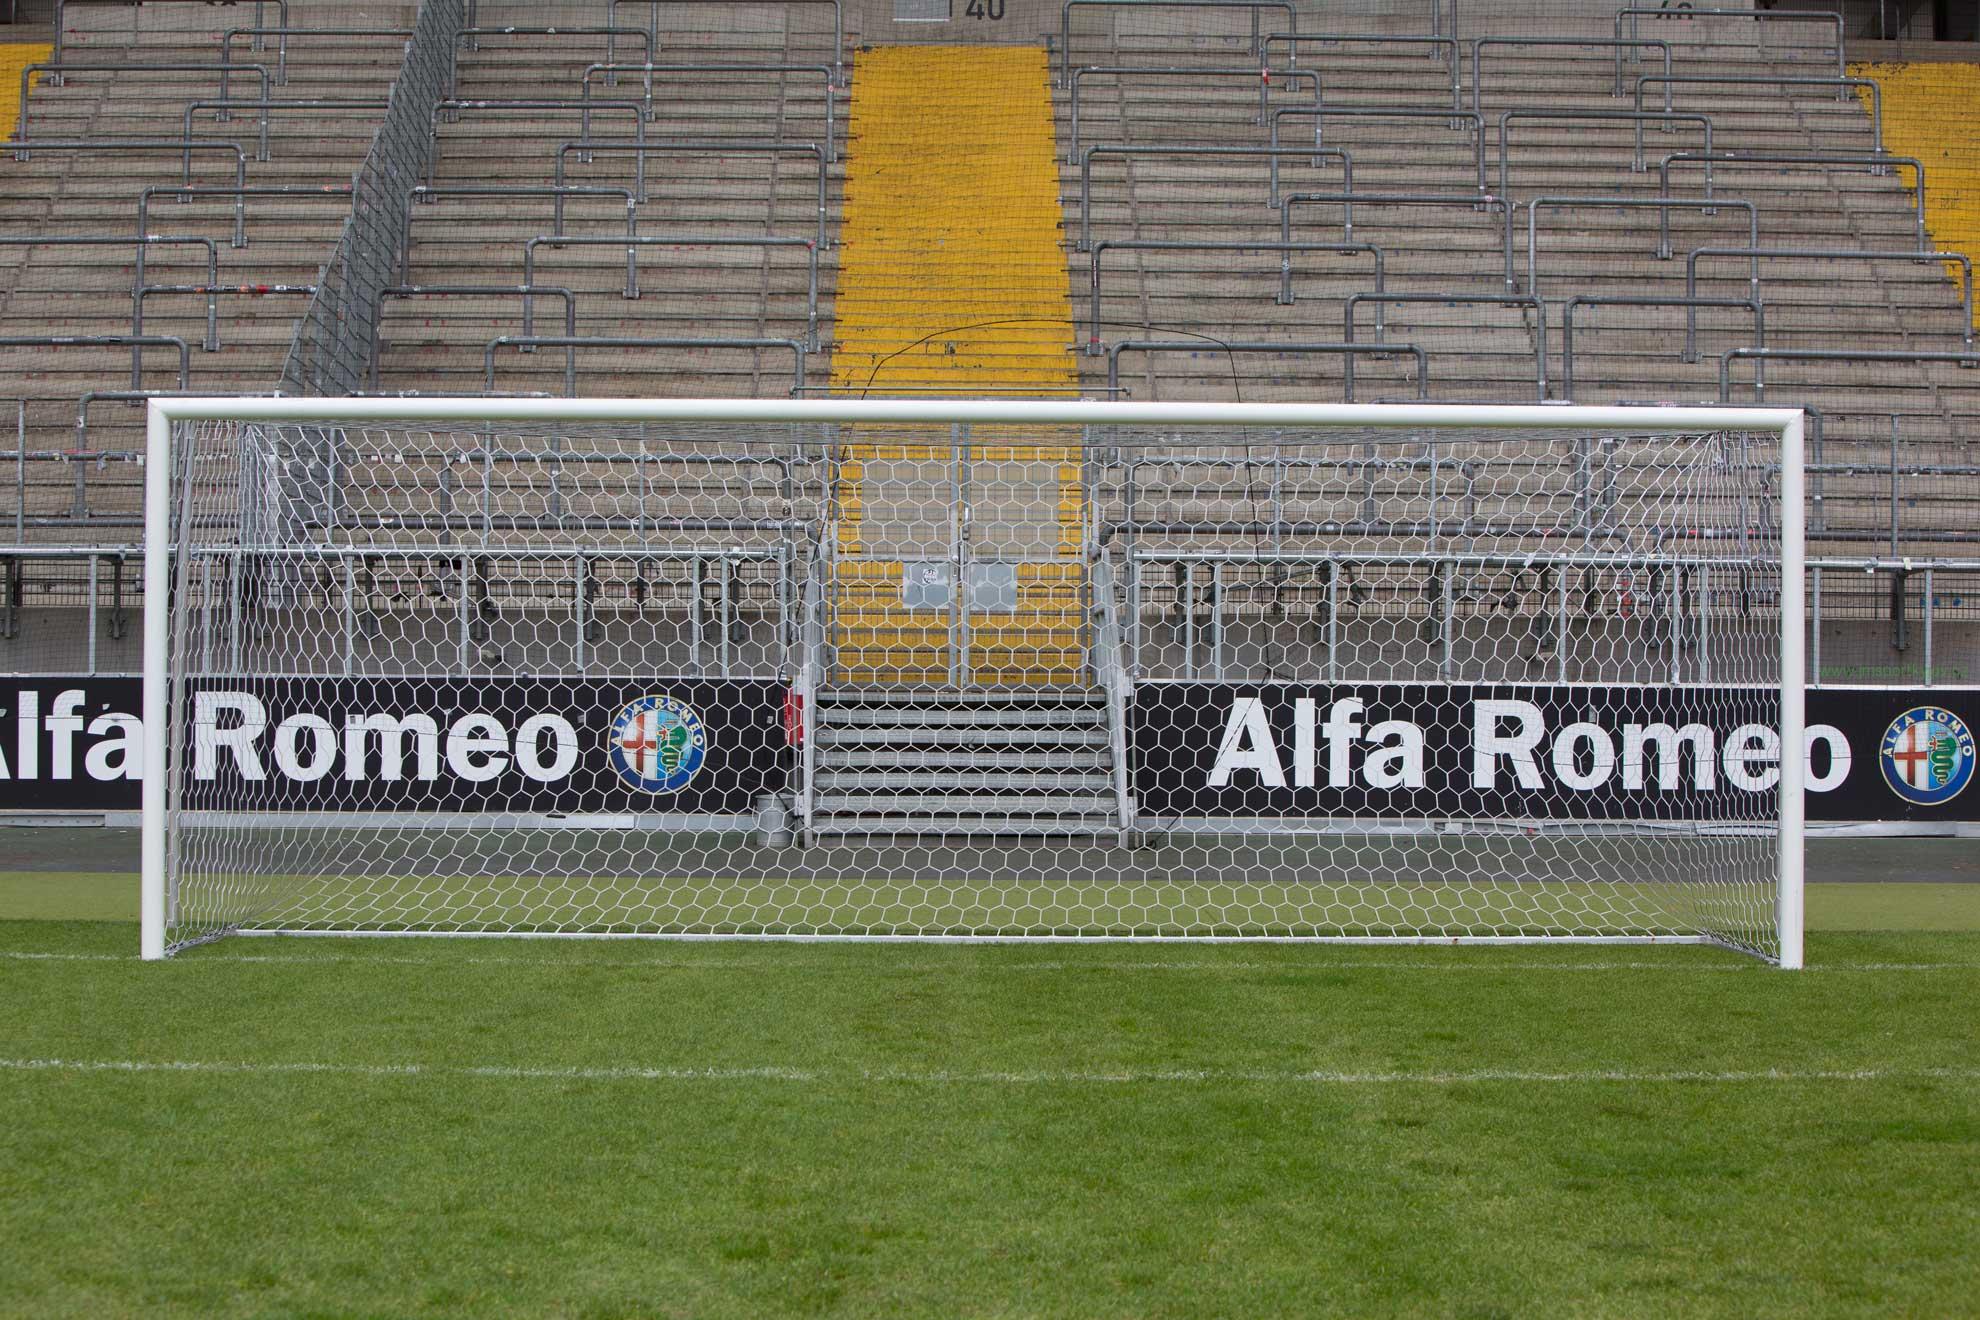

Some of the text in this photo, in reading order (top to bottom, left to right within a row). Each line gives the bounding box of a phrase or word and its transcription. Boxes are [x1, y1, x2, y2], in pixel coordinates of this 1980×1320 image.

[0, 689, 579, 782] lfa Romeo
[611, 698, 704, 747] ALFA ROMEO
[1207, 697, 1852, 792] Alfa Romeo
[1882, 709, 1973, 758] ALFA ROMEO
